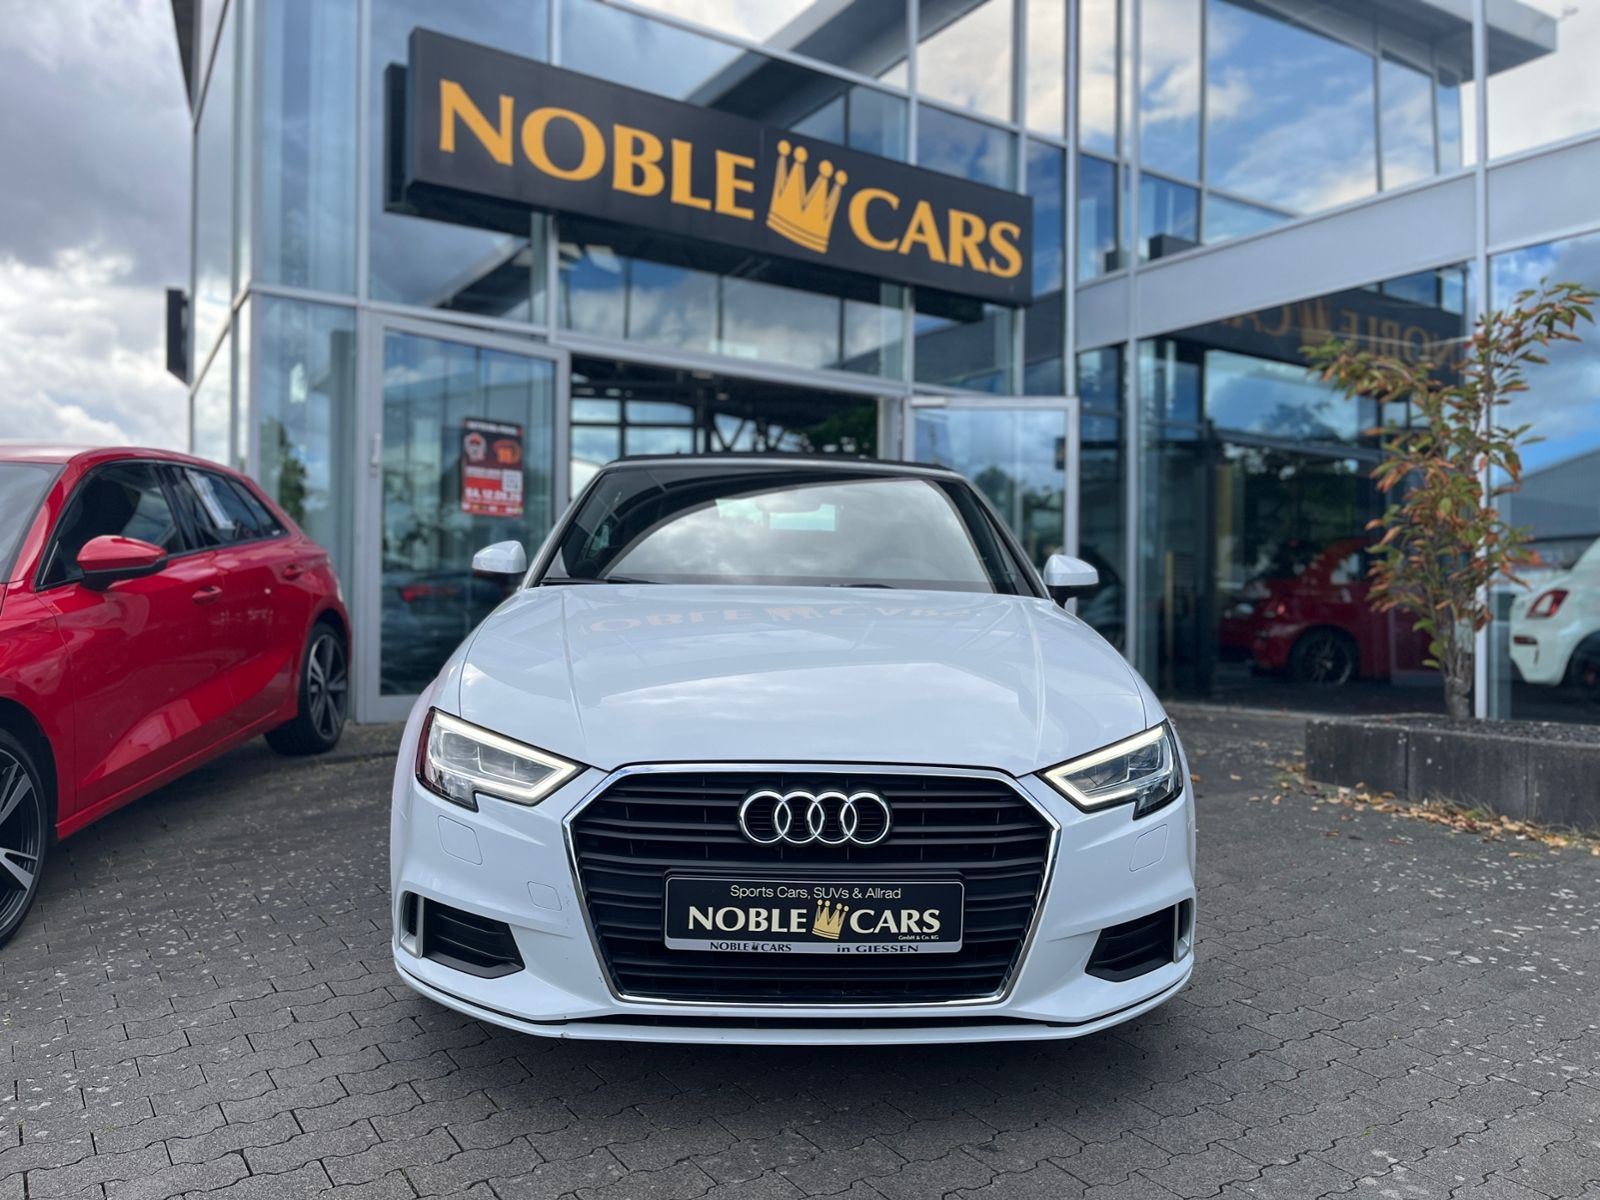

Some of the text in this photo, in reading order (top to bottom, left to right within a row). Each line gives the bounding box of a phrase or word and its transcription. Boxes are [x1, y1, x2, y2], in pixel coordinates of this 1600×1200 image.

[439, 79, 1023, 279] NOBLE CARS
[730, 884, 901, 900] Sports Cars, SUVs & Allrad
[687, 905, 941, 934] NOBLE CARS
[709, 941, 792, 952] NOBLE CARS
[837, 944, 919, 953] in GIESSEN
